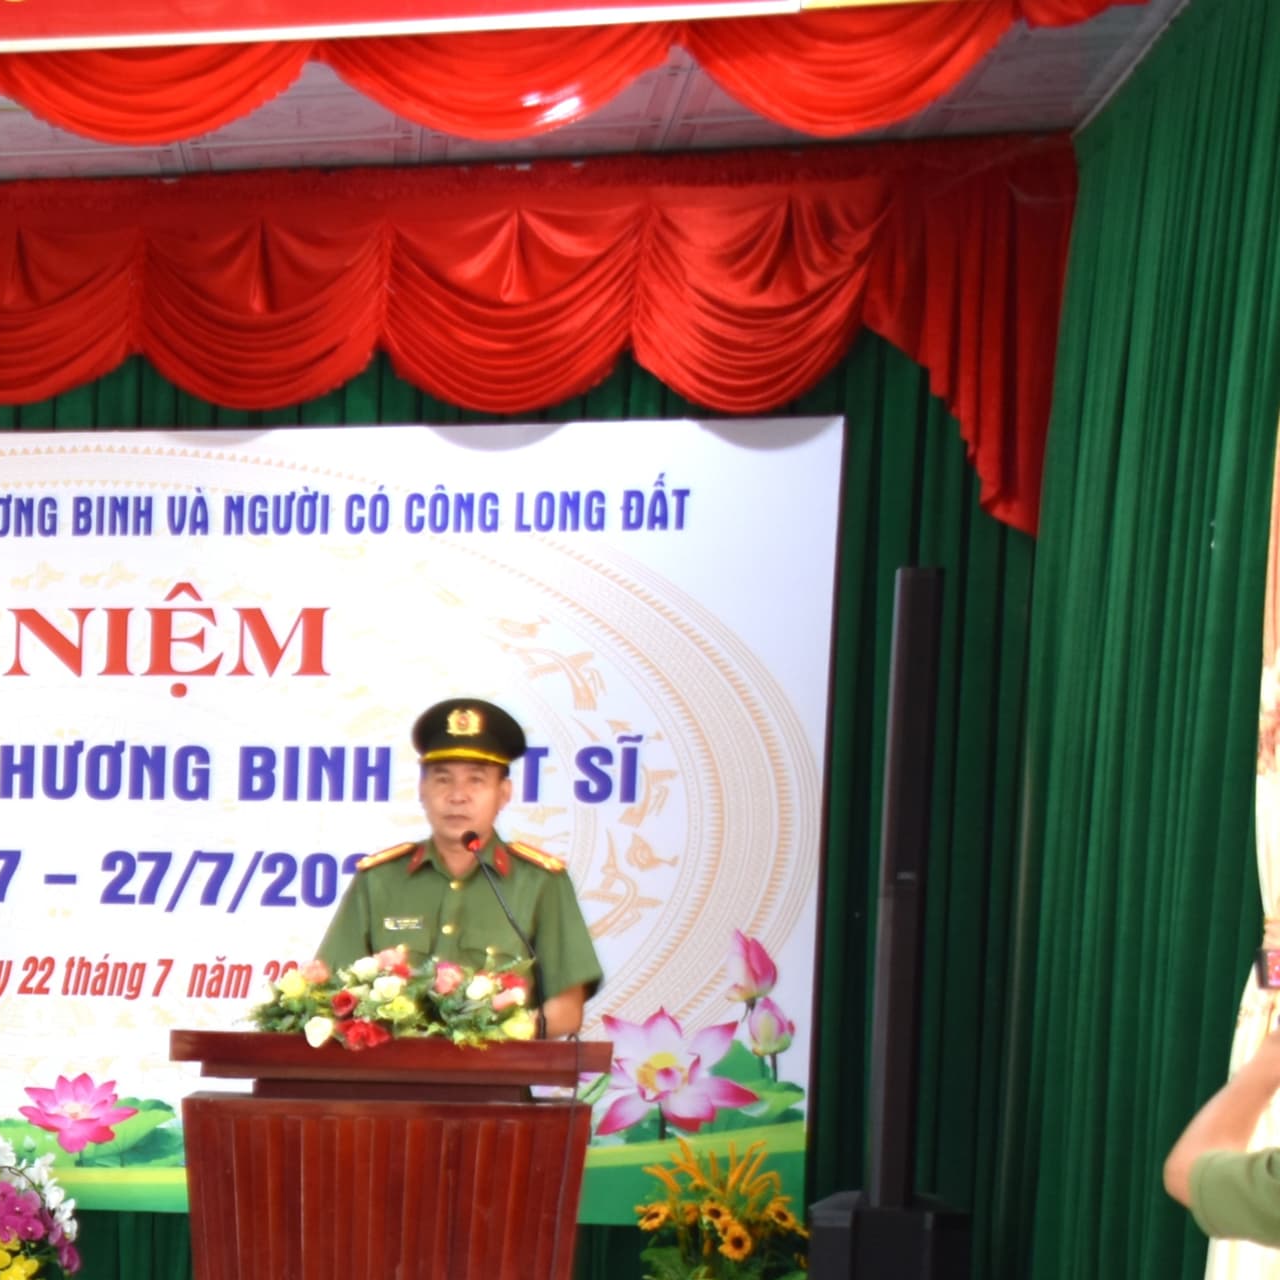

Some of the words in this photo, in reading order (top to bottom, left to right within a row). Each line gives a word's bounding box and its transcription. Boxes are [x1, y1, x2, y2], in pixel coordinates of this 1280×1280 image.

[72, 496, 153, 536] BINH
[167, 487, 209, 535] VÀ
[223, 485, 330, 535] NGƯỜI
[345, 484, 390, 534] CÓ
[404, 484, 499, 533] CÔNG
[515, 490, 606, 532] LONG
[620, 472, 691, 531] ĐẤT
[3, 582, 331, 698] NIỆM
[239, 746, 391, 802] BINH
[574, 735, 643, 803] SĨ
[17, 956, 56, 995] 22
[61, 954, 146, 1000] tháng
[152, 959, 174, 997] 7
[186, 956, 253, 998] năm
